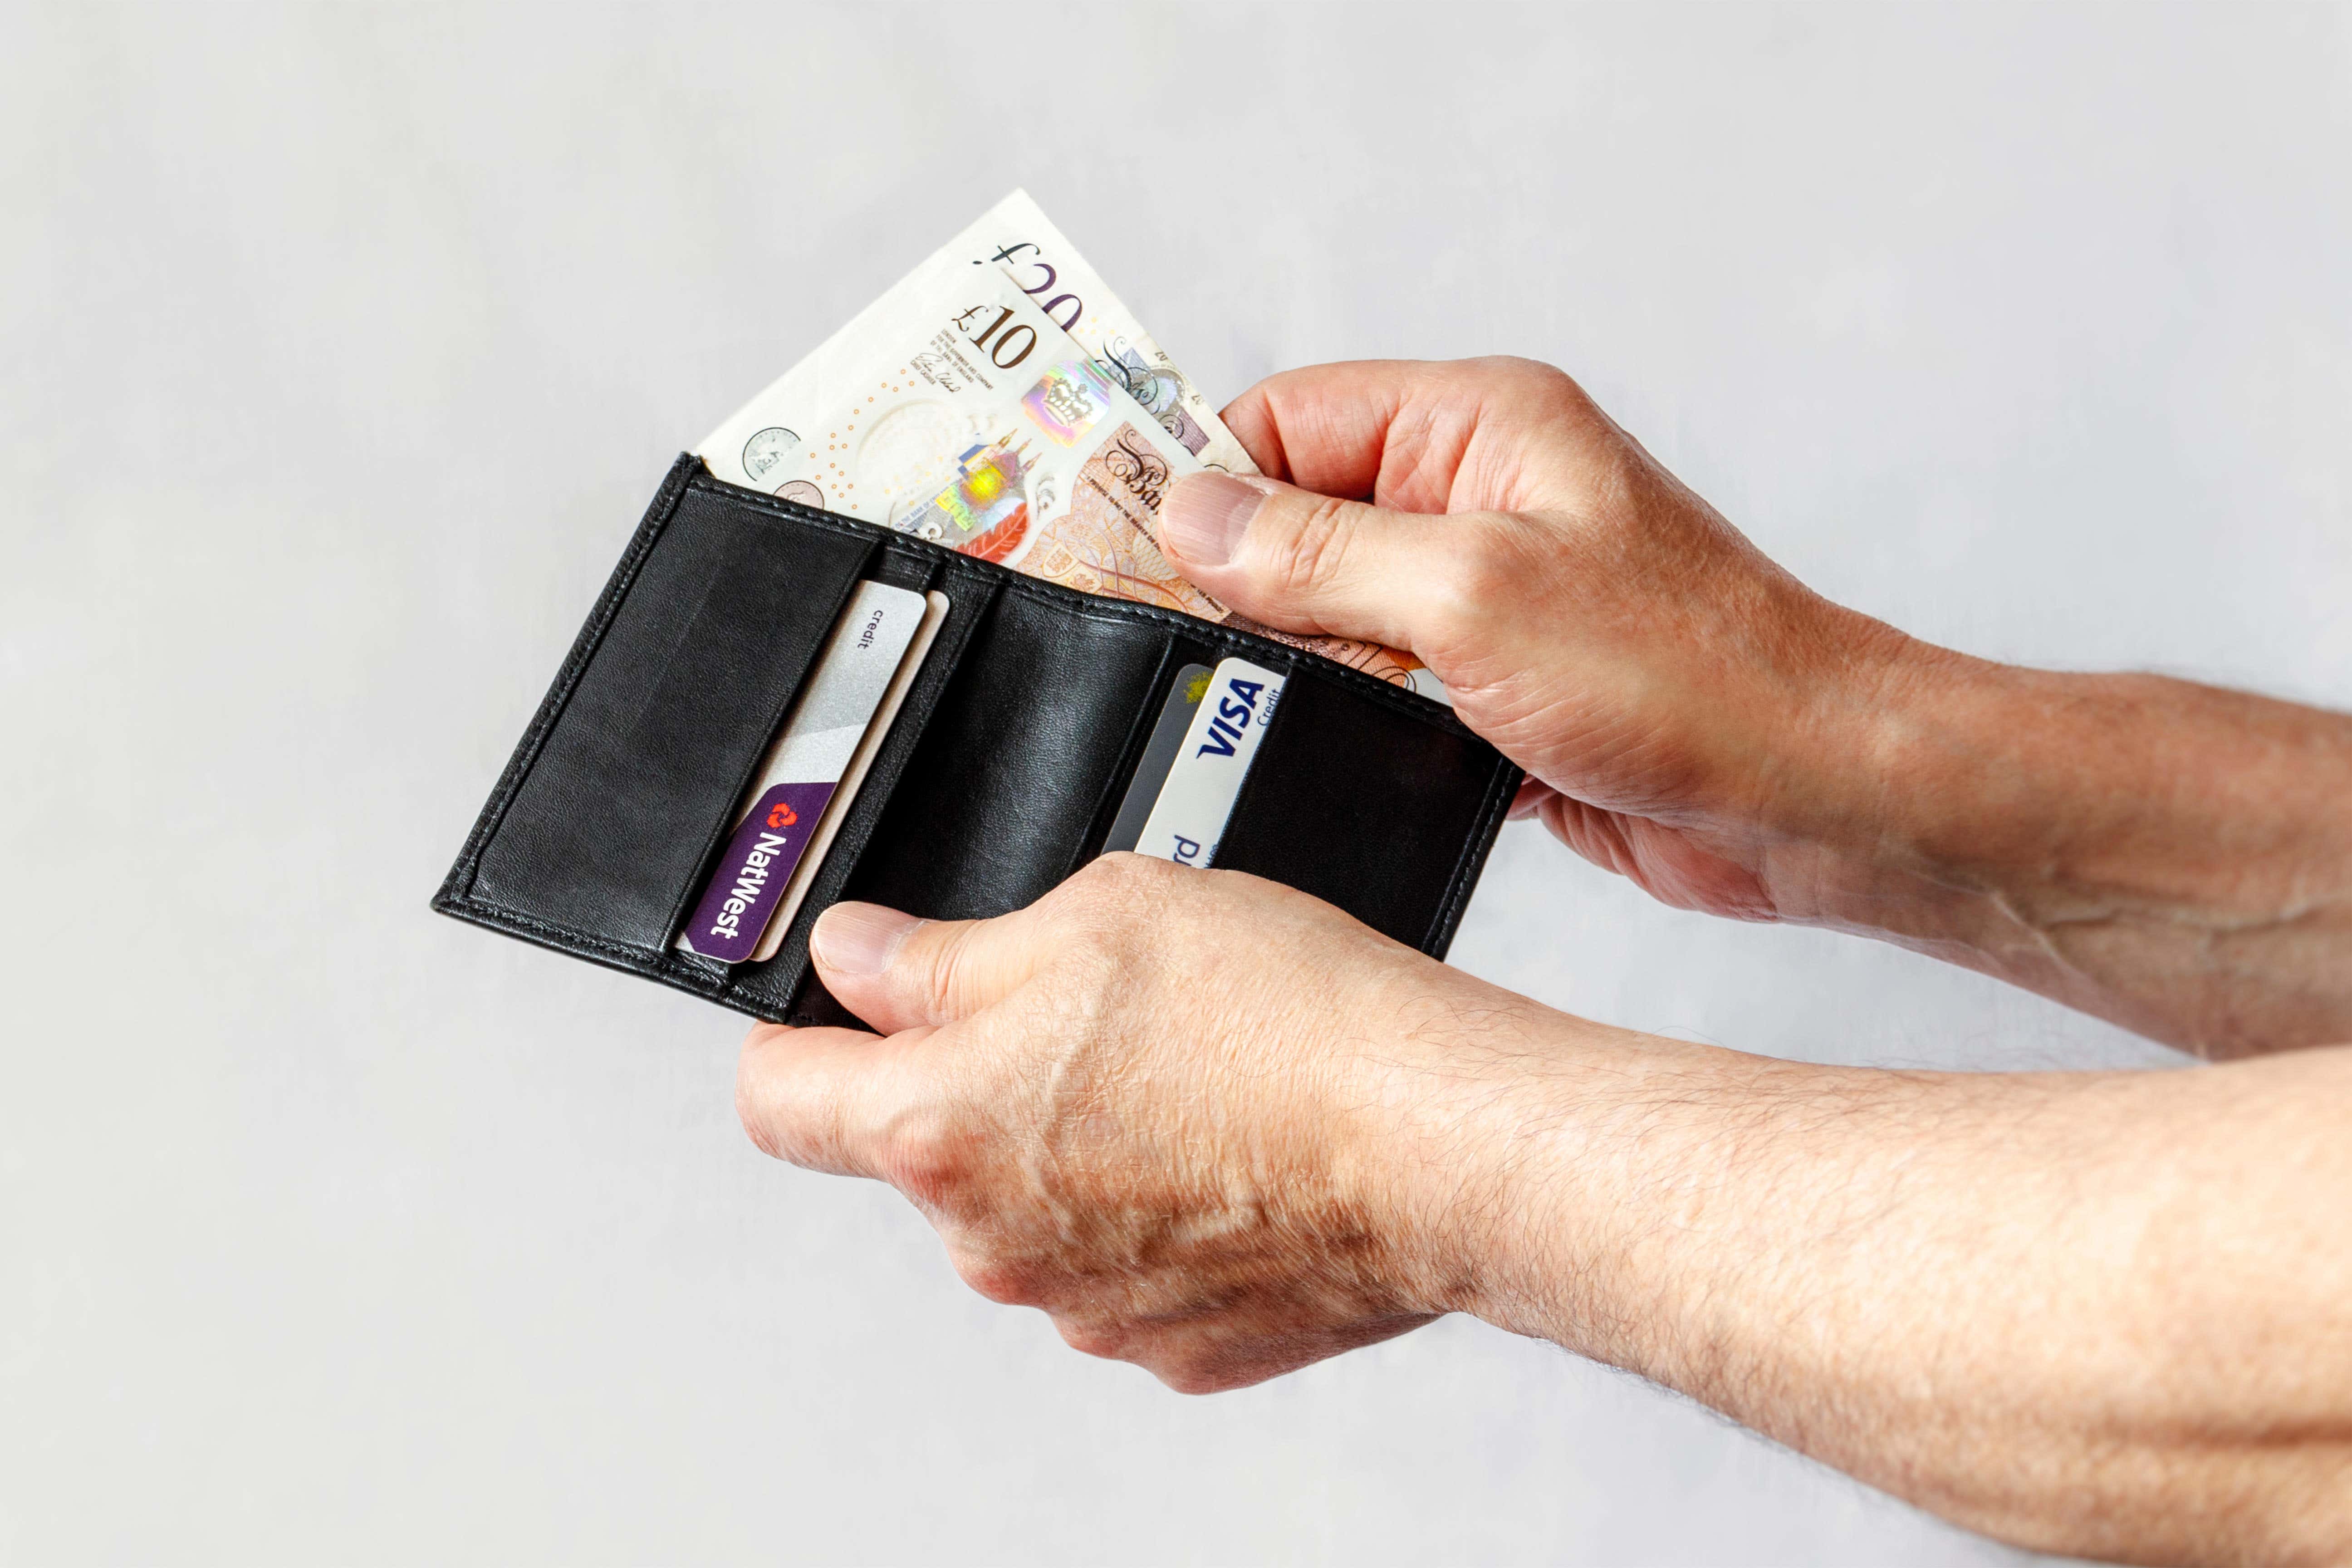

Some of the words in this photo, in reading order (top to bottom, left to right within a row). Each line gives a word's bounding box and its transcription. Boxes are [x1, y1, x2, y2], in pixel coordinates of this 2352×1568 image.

[941, 328, 956, 343] LONDON
[951, 305, 1037, 369] £10
[921, 370, 936, 385] CASHIER
[936, 334, 944, 343] FOR
[950, 348, 969, 367] GOVERNOR
[976, 373, 994, 390] COMPANY
[957, 366, 974, 383] ENGLAND
[1090, 479, 1109, 497] PROMISE
[1122, 510, 1132, 519] THE
[1130, 518, 1148, 536] BEARER
[1147, 535, 1156, 543] ON
[858, 610, 883, 649] credit
[1196, 678, 1265, 759] VISA
[1257, 688, 1280, 726] Credit
[710, 832, 787, 939] NatWest
